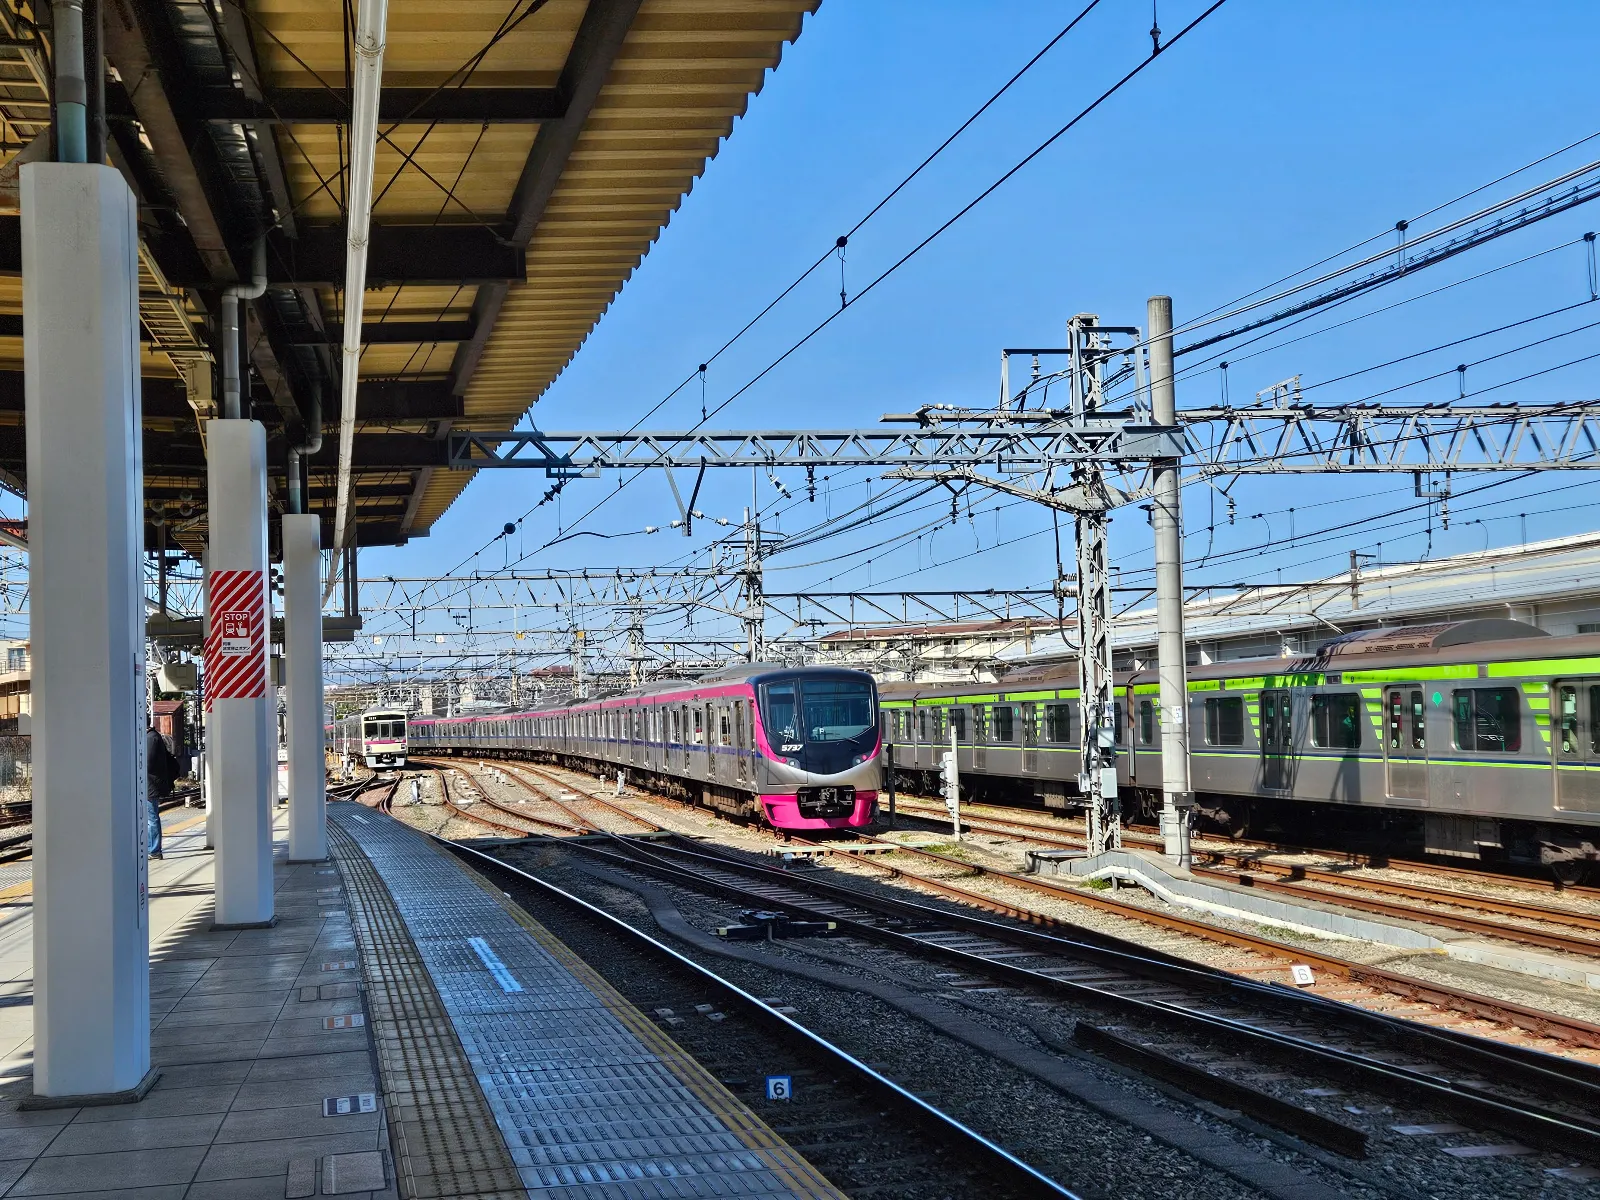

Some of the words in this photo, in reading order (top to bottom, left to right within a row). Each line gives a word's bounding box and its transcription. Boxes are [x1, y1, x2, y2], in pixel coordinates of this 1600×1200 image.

[224, 613, 247, 621] STOP
[781, 744, 803, 752] 5737
[1297, 968, 1309, 981] 6
[773, 1081, 785, 1096] 6
